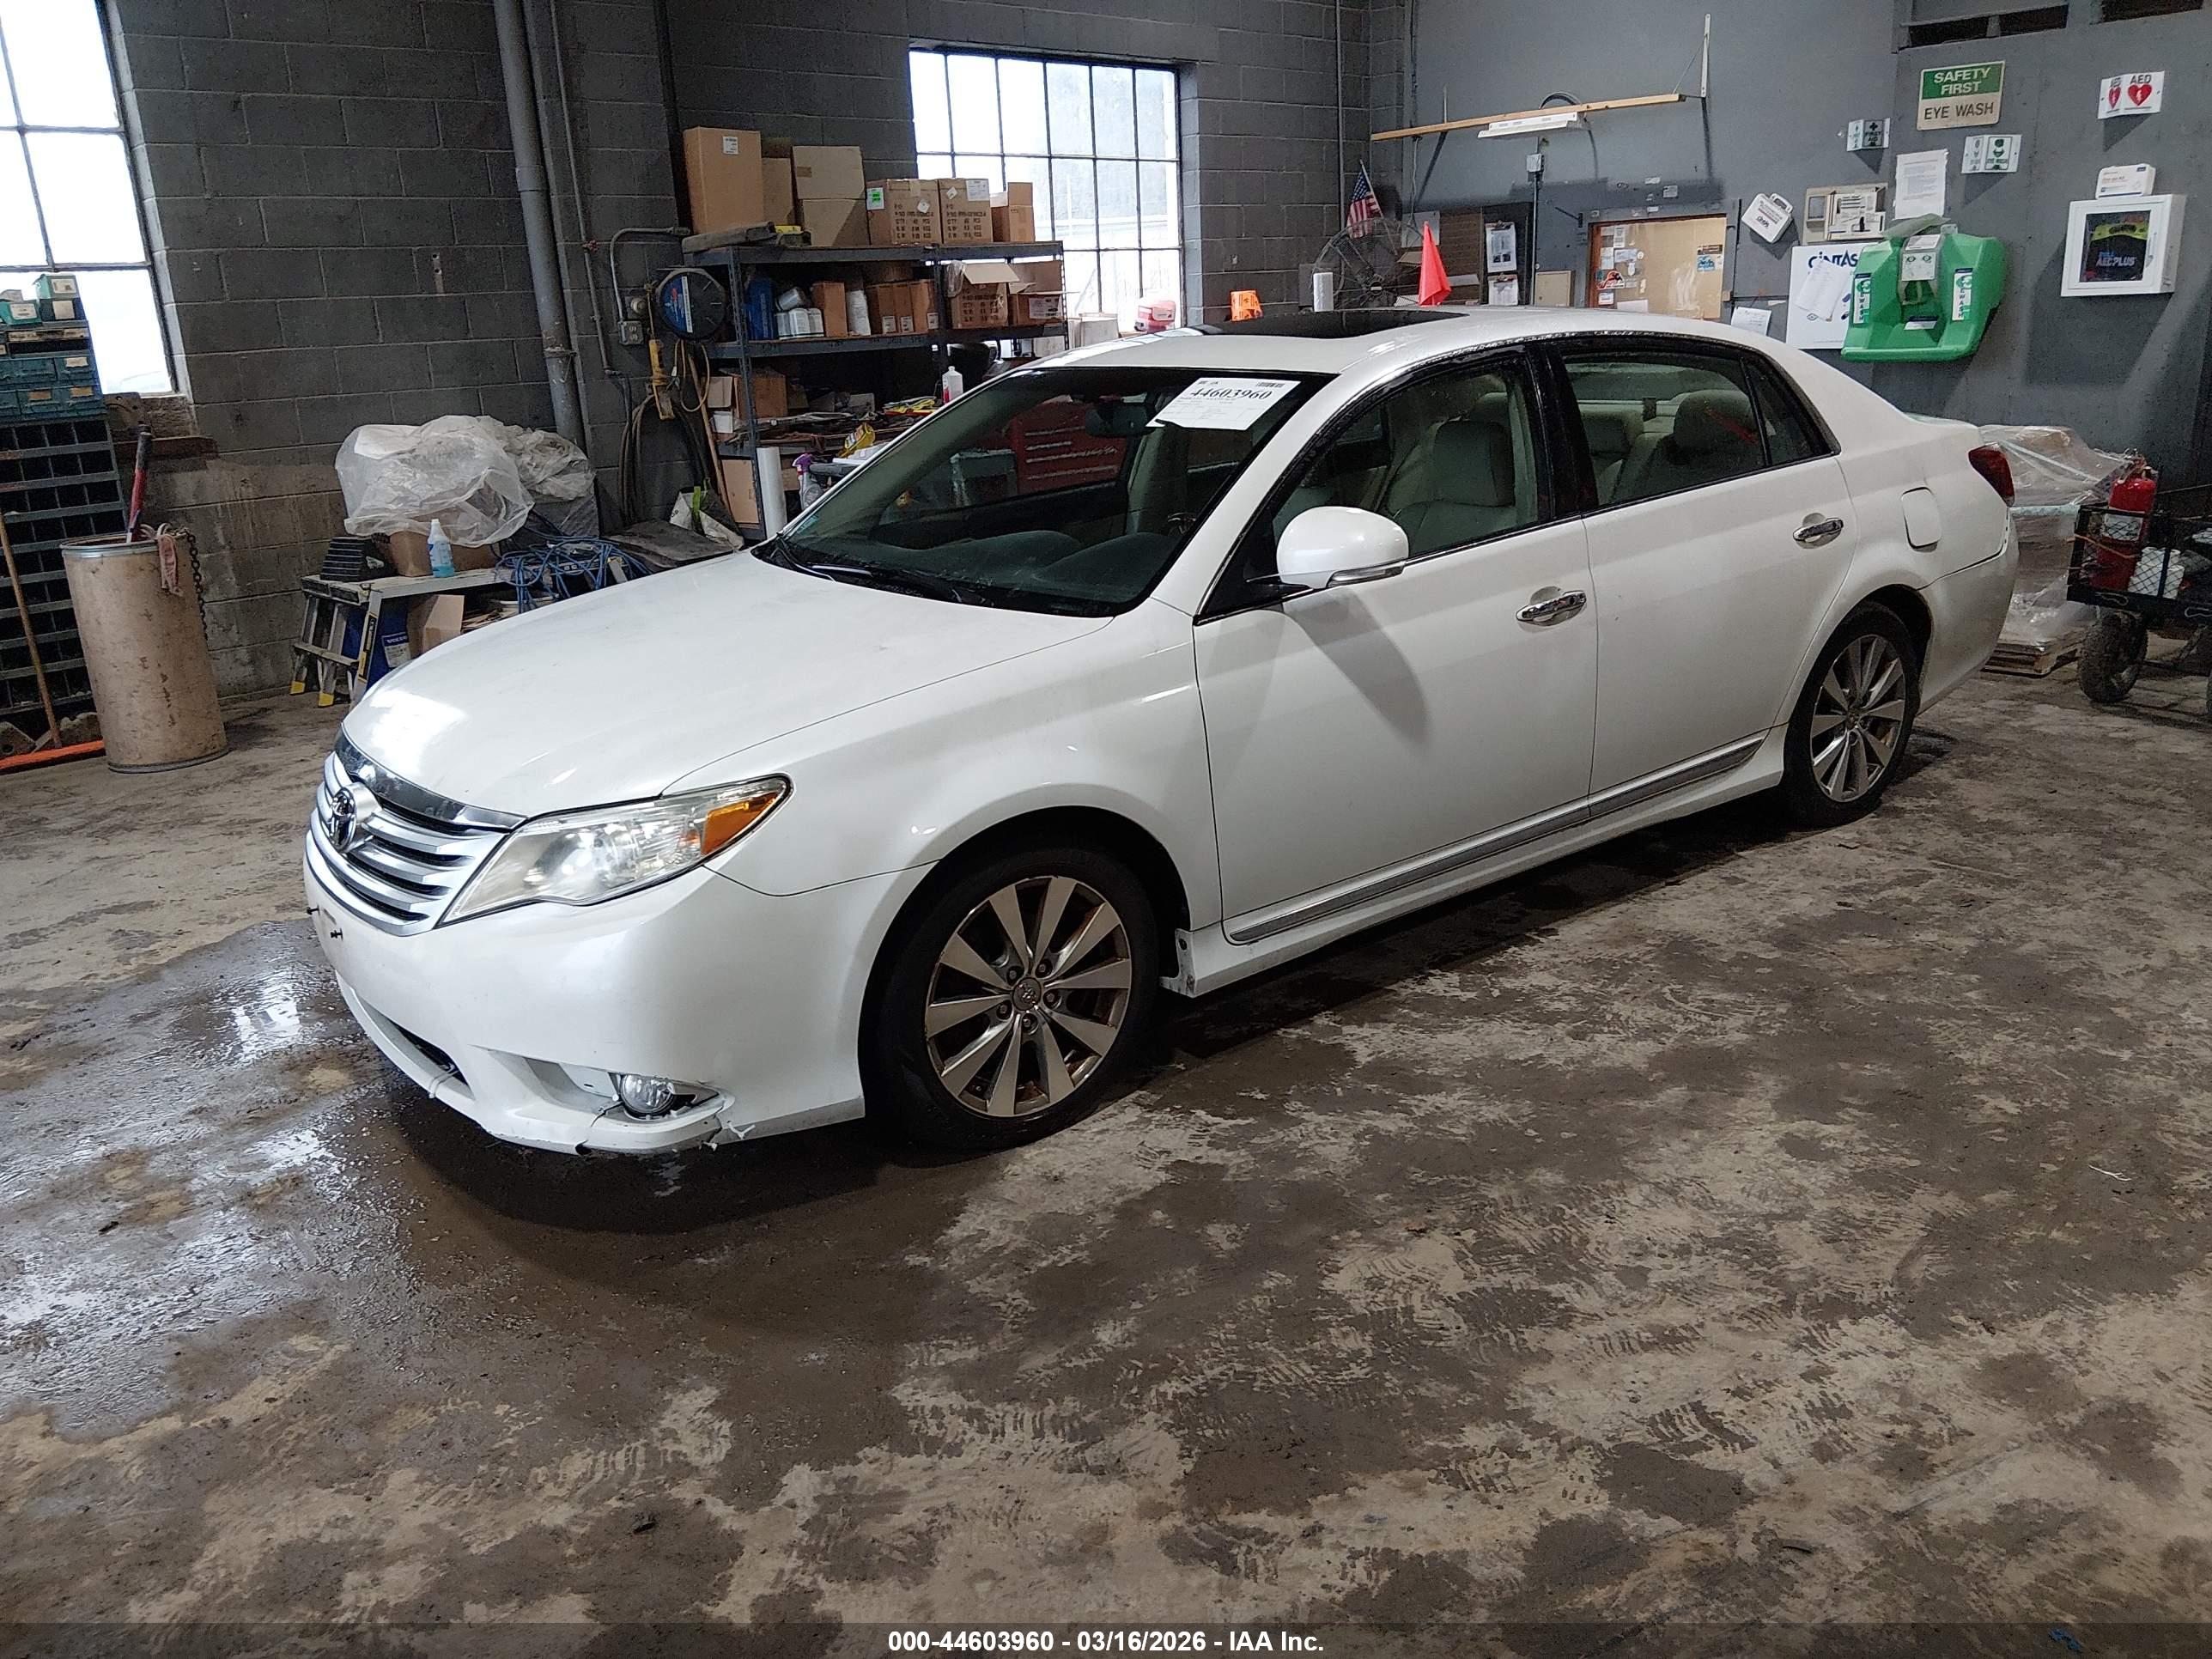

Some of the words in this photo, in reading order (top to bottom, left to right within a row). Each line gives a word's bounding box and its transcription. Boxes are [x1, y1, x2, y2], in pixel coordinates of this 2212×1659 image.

[1934, 67, 1991, 83] SAFETY
[2130, 75, 2152, 84] AED
[1941, 81, 1982, 95] FIRST
[1924, 106, 1950, 120] EYE
[1956, 101, 1994, 117] WASH
[1191, 387, 1273, 400] 44603960
